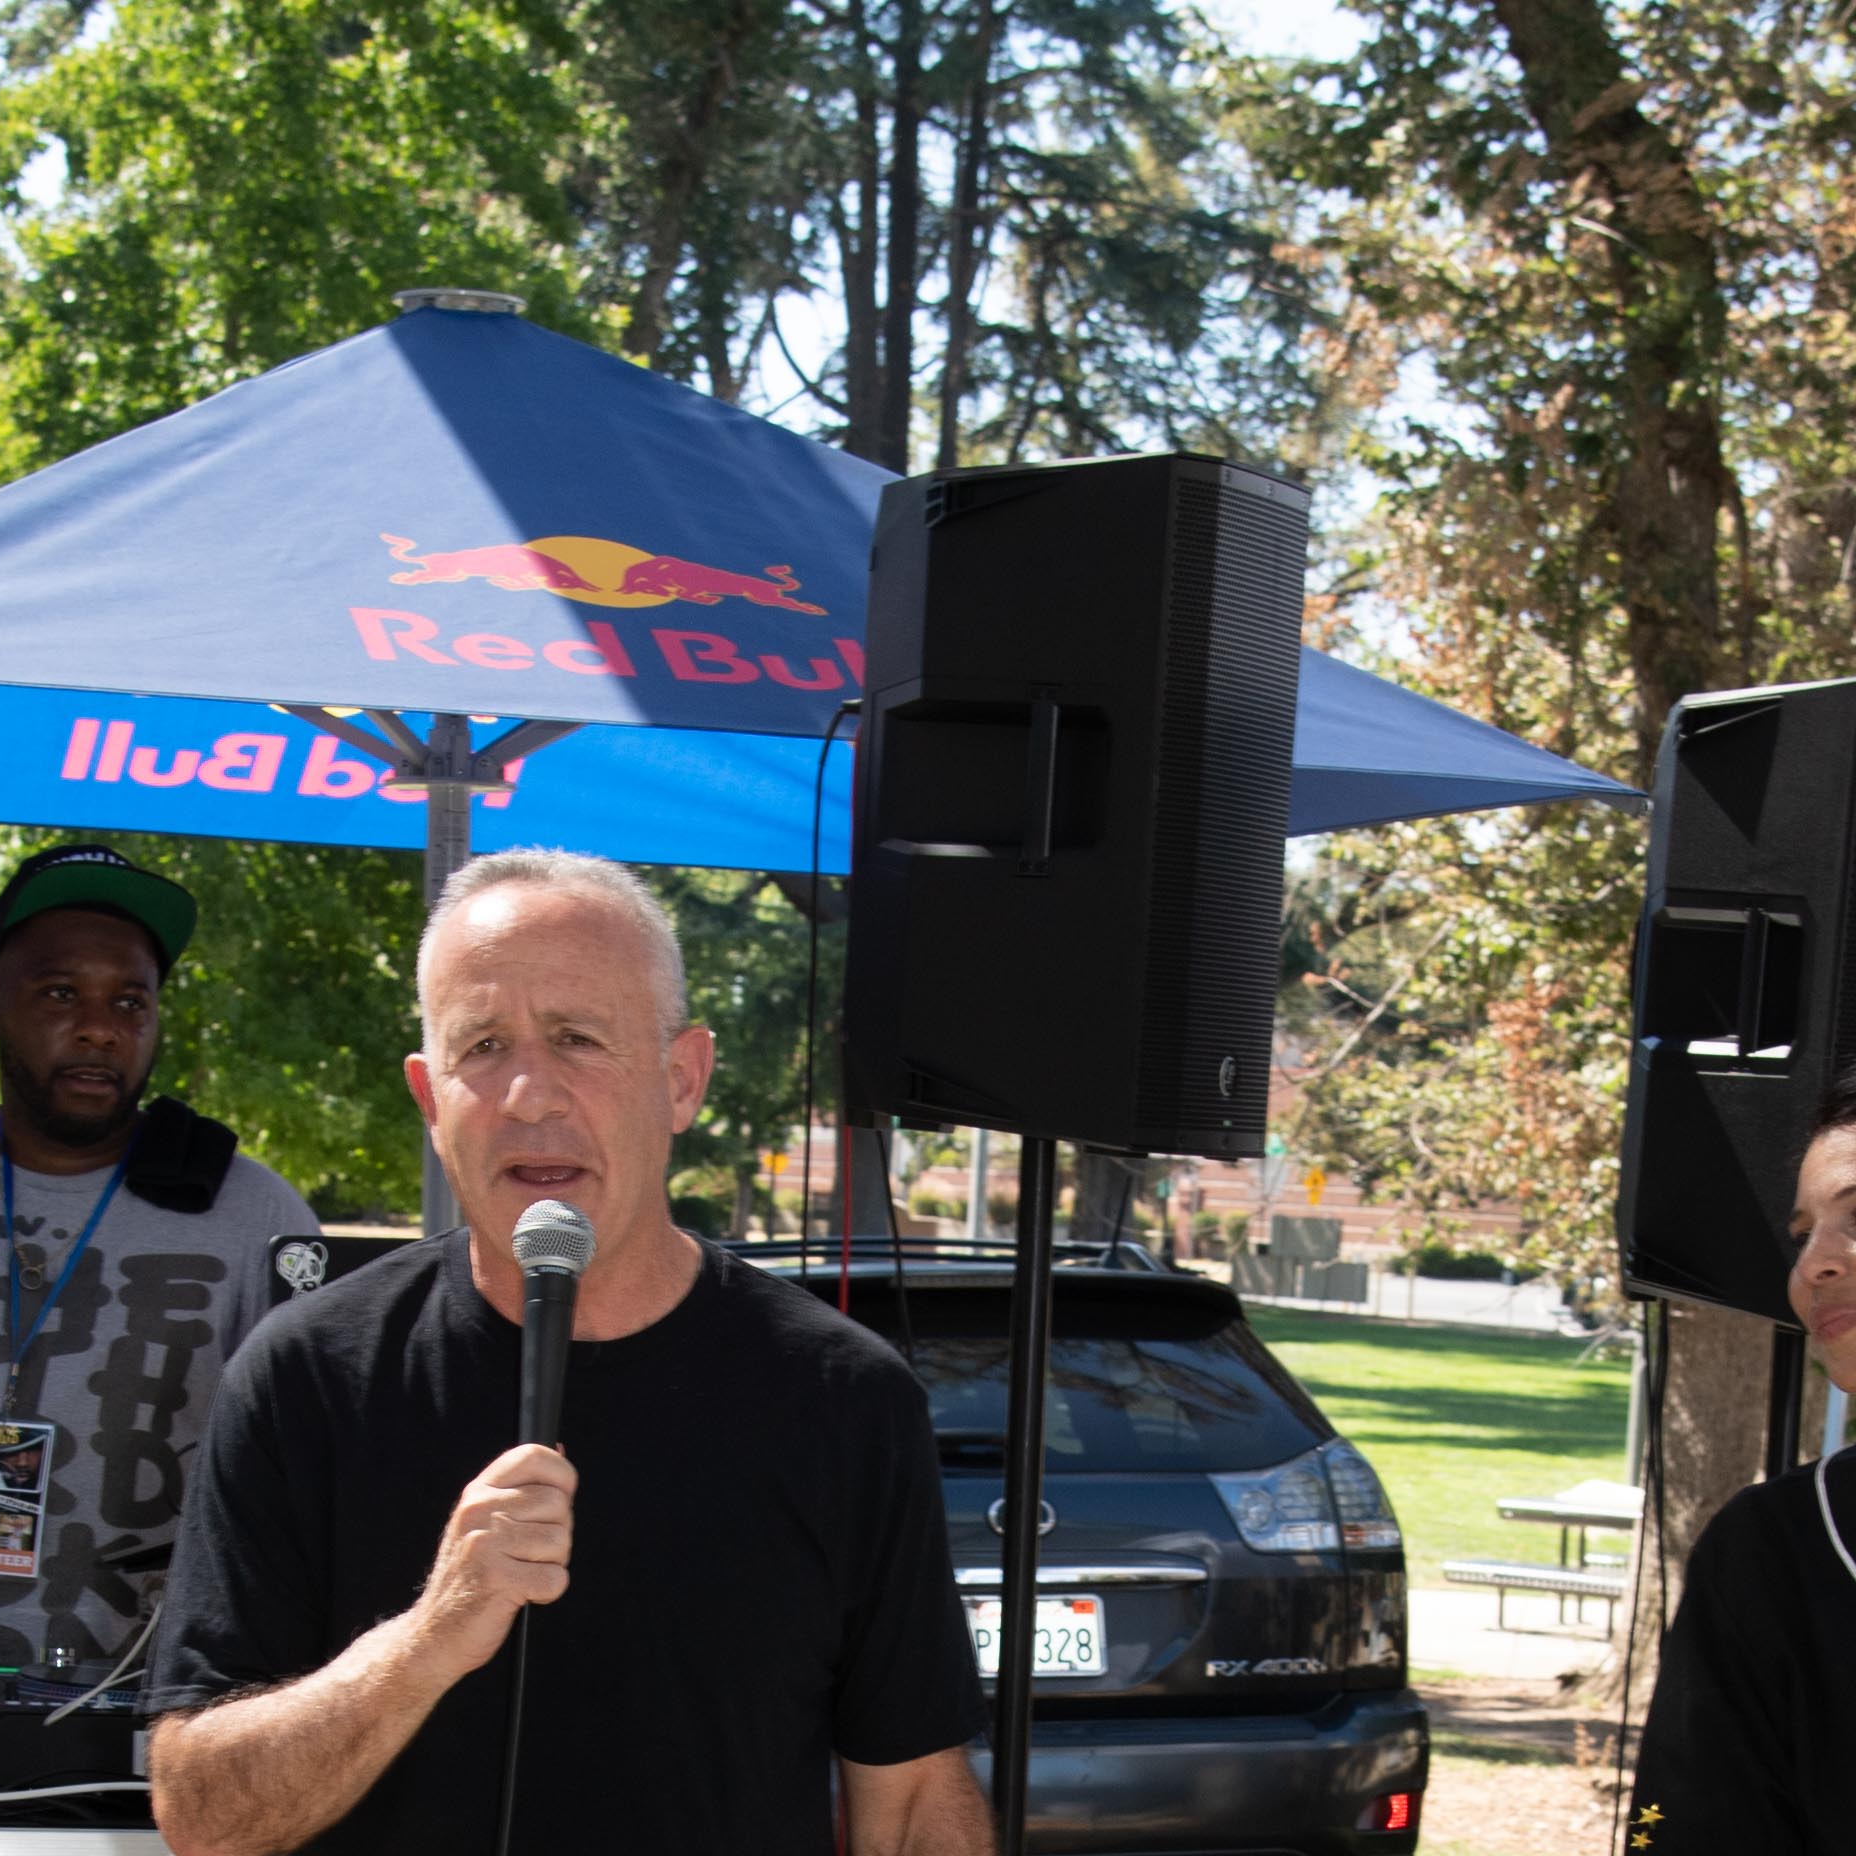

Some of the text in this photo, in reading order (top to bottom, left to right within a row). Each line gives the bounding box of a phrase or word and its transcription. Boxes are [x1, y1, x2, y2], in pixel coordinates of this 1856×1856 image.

[348, 606, 866, 692] Red Bul
[975, 1626, 1093, 1663] P328
[1205, 1658, 1250, 1678] RX
